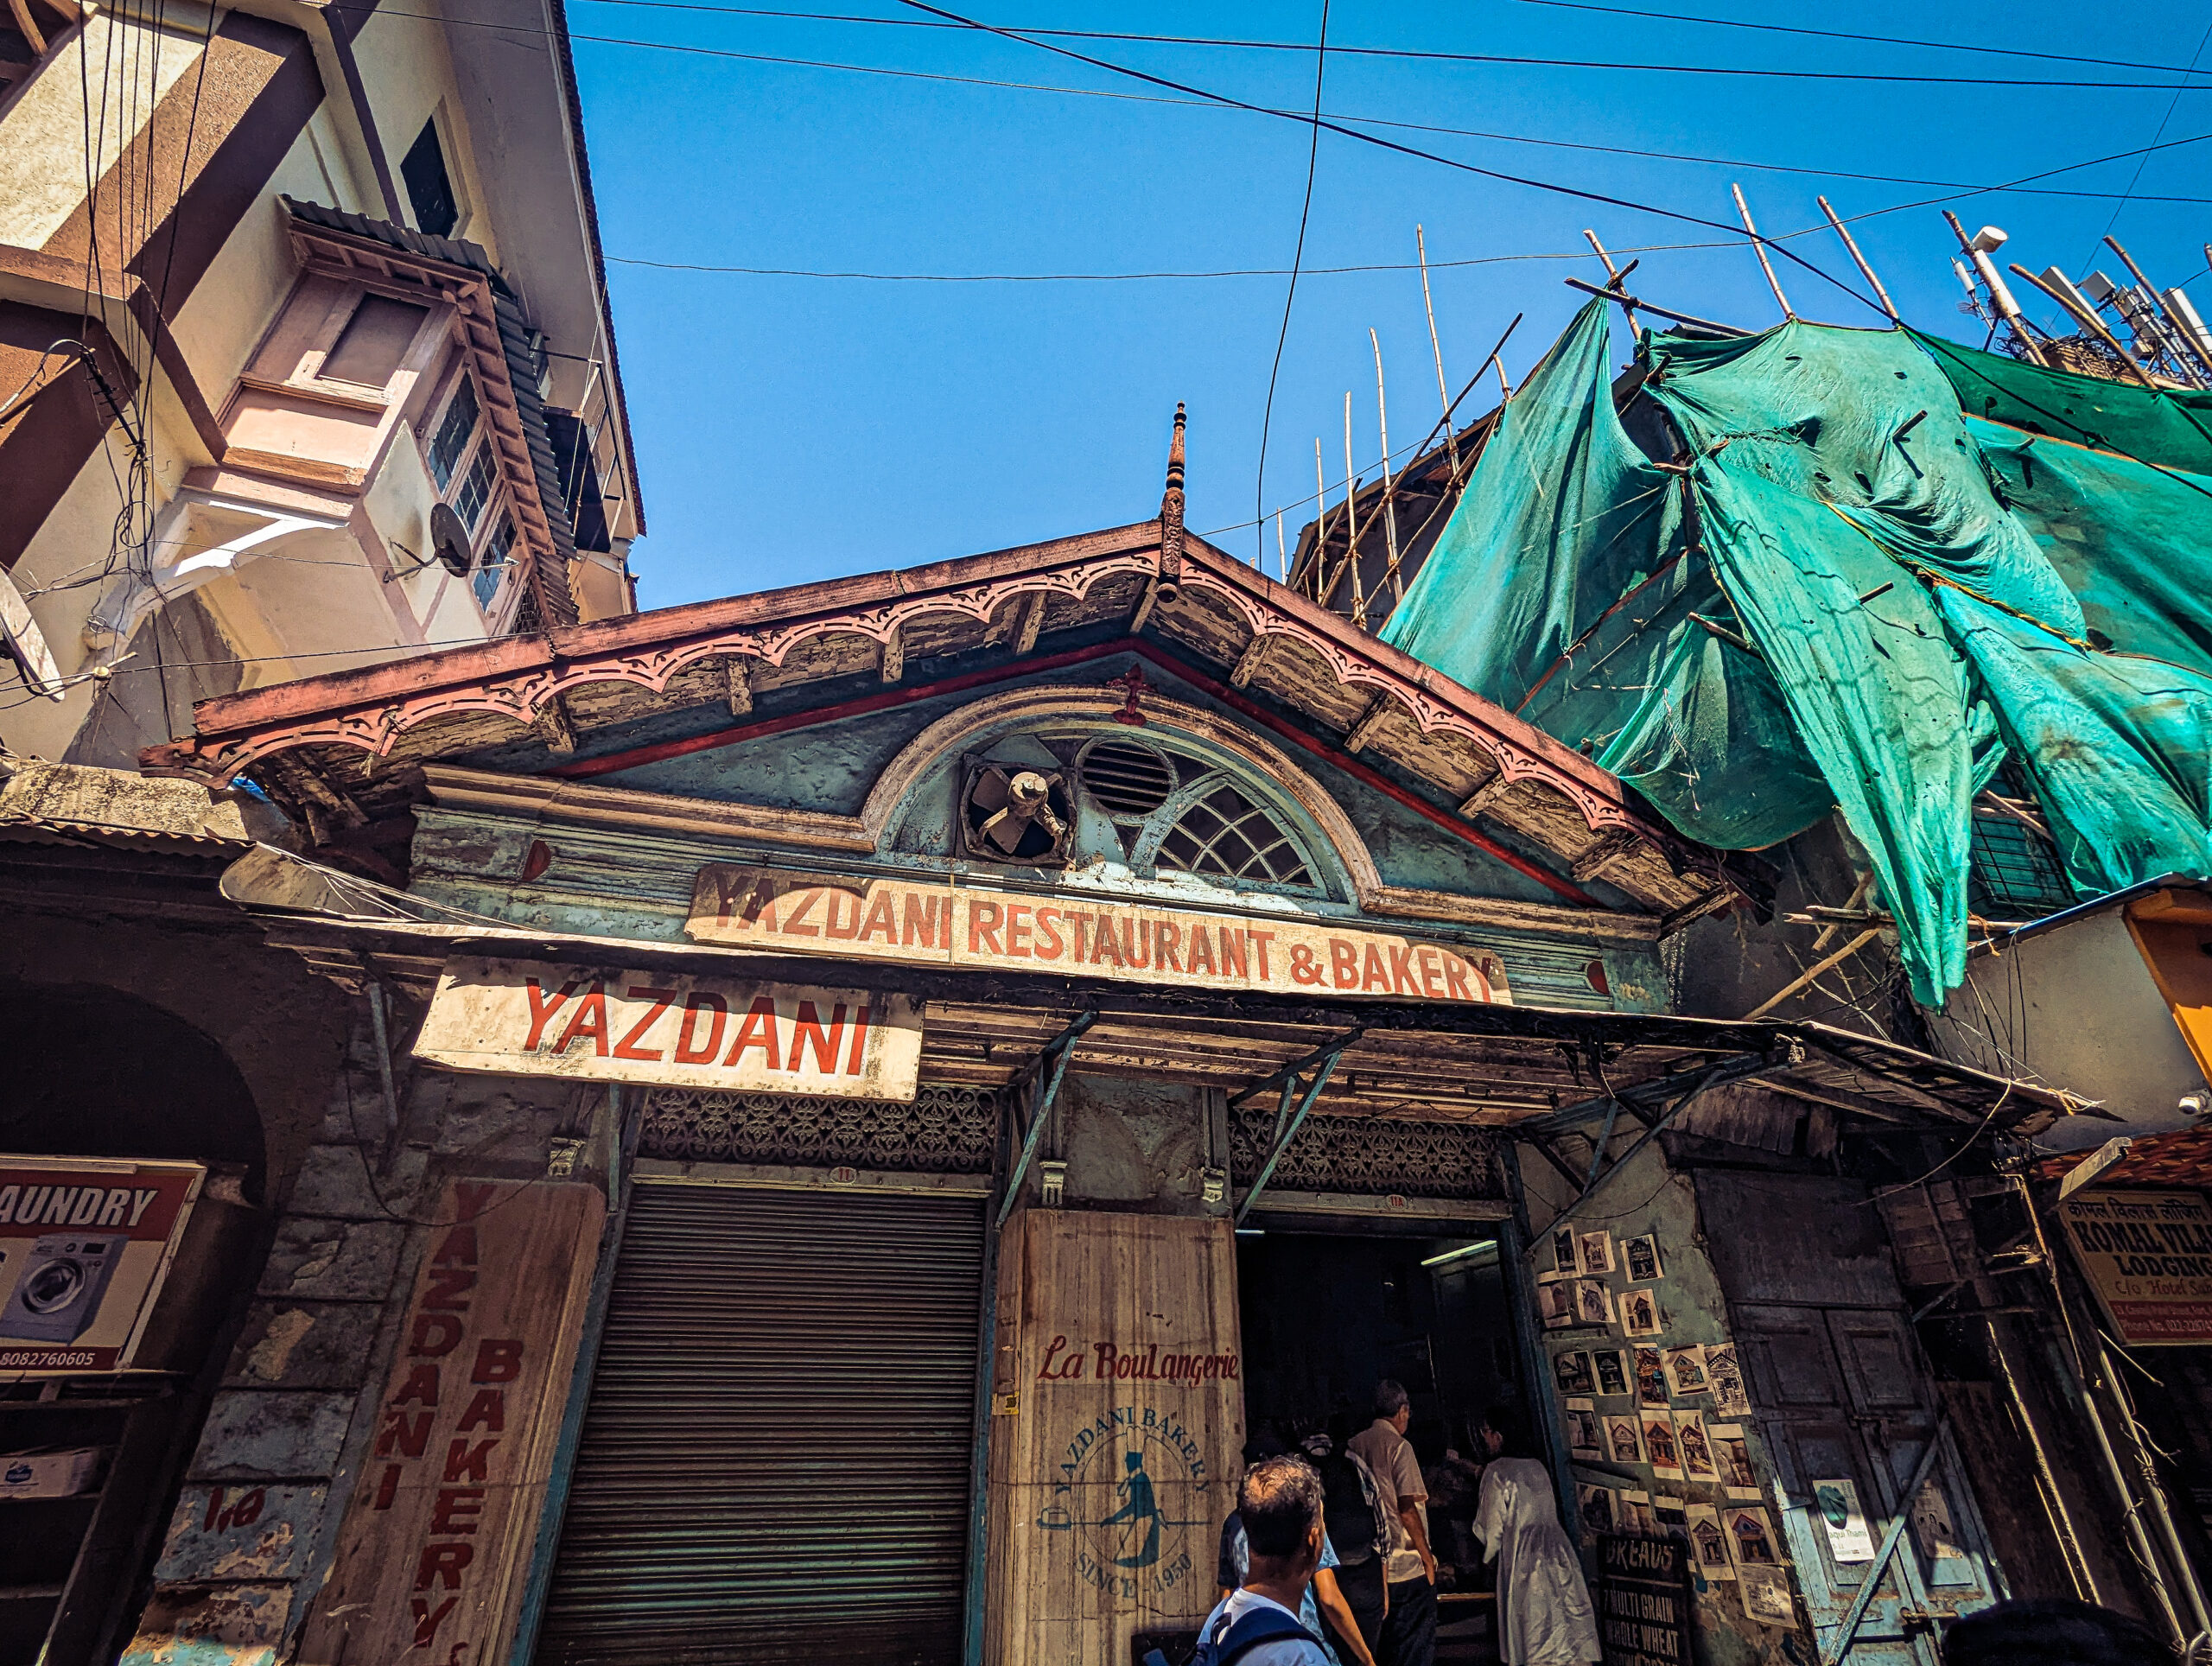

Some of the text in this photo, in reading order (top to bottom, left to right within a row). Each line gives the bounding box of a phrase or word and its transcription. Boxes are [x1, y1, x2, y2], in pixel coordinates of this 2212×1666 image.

[714, 874, 1492, 1003] YAZDANI RESTAURANT & BAKERY
[523, 976, 868, 1076] YAZDANI
[2070, 1221, 2167, 1253] KOMAL
[0, 1351, 96, 1366] 8082760605
[373, 1184, 498, 1510] YAZDANI
[1037, 1334, 1084, 1380] La
[1054, 1406, 1211, 1497] YAZDANI BAKERY
[410, 1339, 524, 1649] BAKERY
[1073, 1552, 1136, 1599] SINCE
[1154, 1553, 1192, 1593] 1950
[1641, 1594, 1675, 1624] GRAIN
[1641, 1625, 1678, 1657] WHEAT
